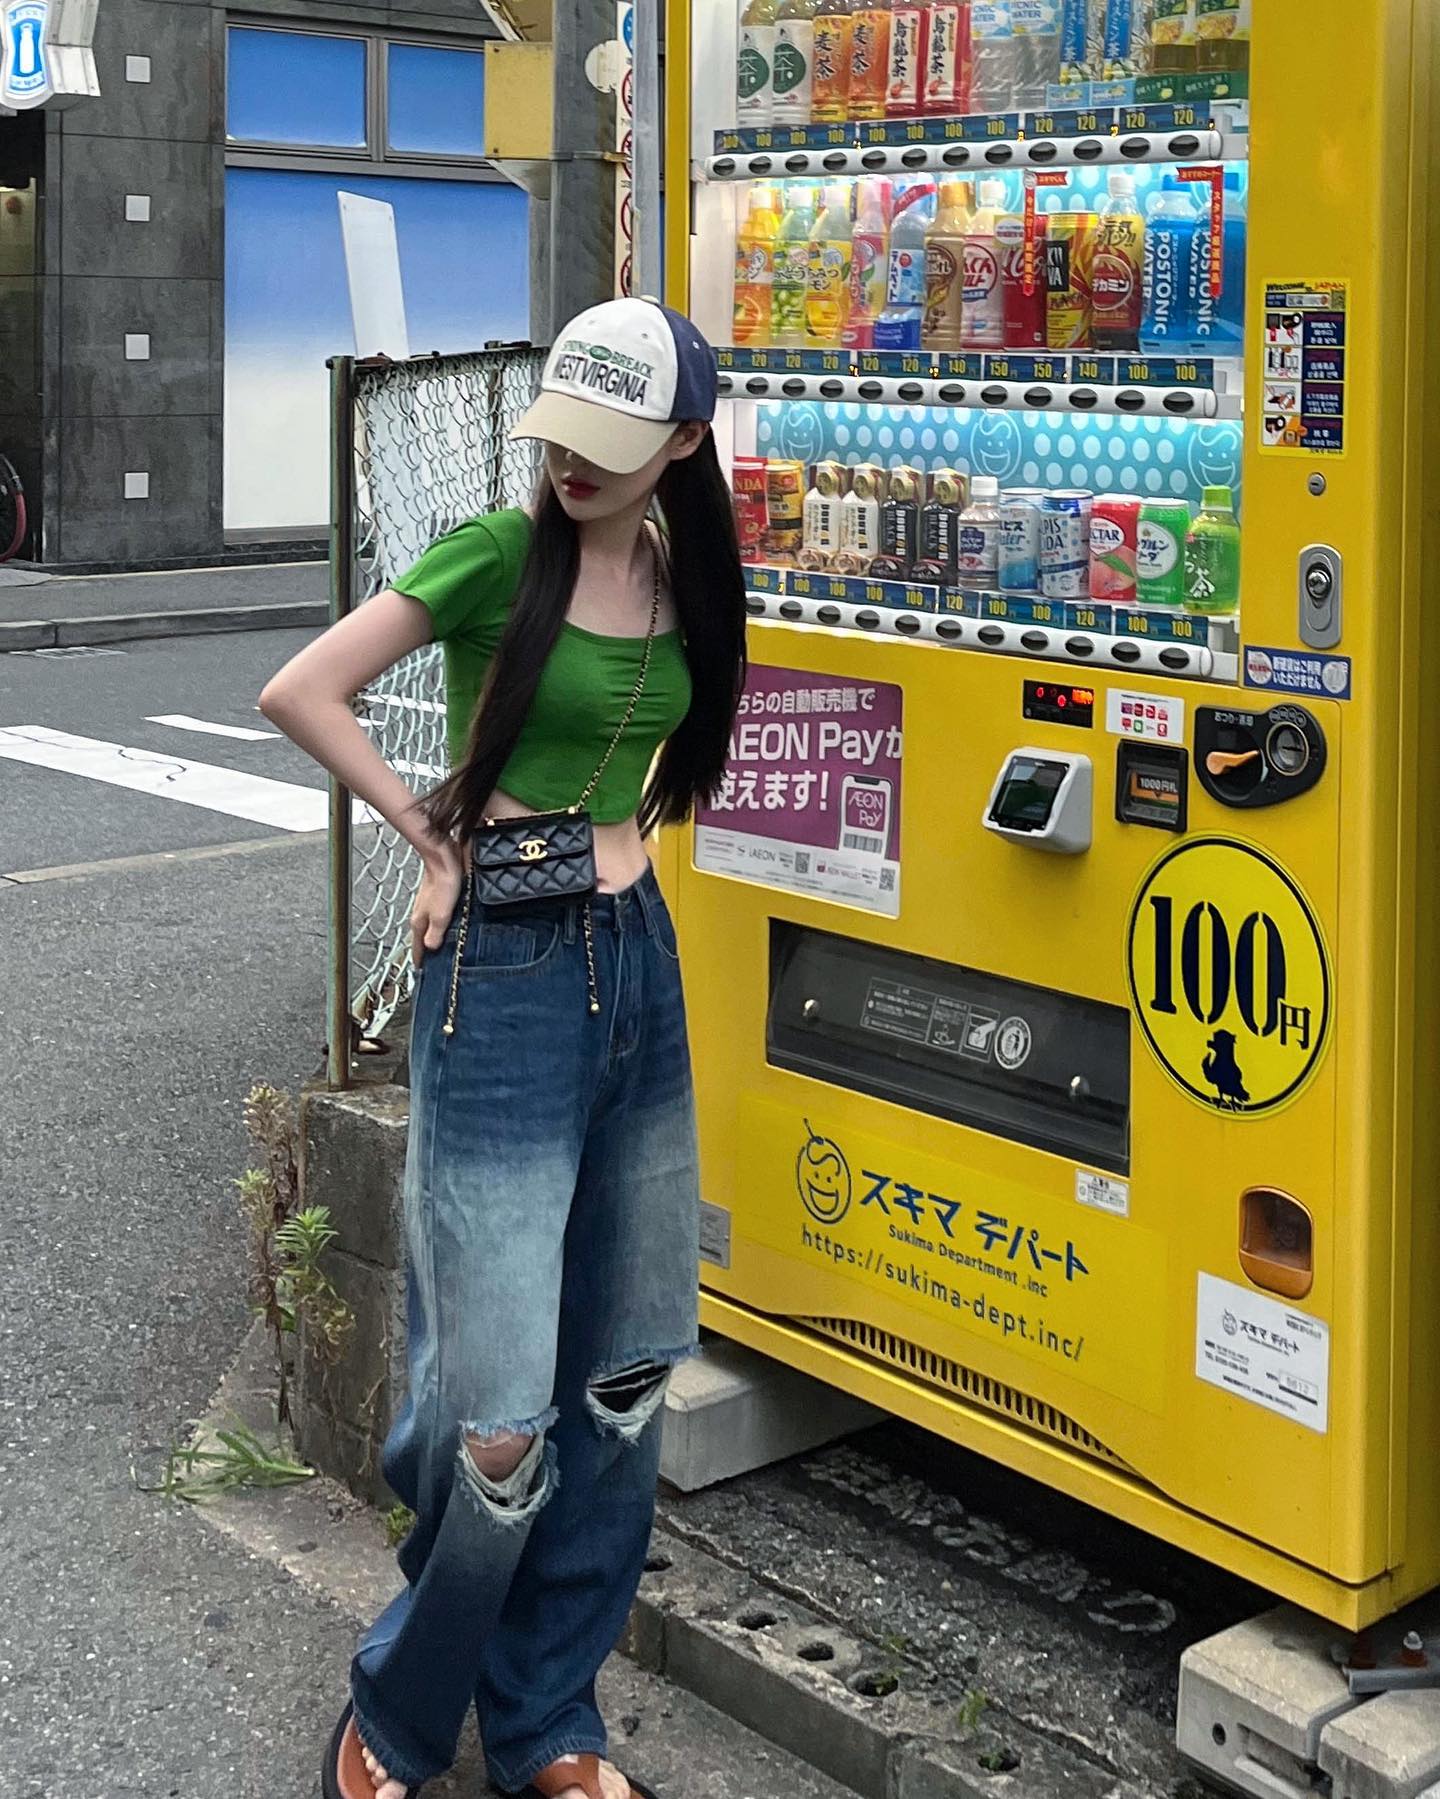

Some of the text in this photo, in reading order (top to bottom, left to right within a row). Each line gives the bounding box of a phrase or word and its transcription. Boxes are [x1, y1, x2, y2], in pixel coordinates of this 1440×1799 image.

[814, 30, 836, 81] 麦茶
[852, 24, 871, 76] 麦茶
[756, 132, 772, 147] 100
[790, 130, 806, 145] 100
[828, 128, 845, 143] 100
[868, 128, 886, 142] 100
[907, 125, 924, 140] 100
[945, 123, 963, 138] 100
[987, 120, 1005, 135] 100
[1034, 116, 1053, 133] 120
[1077, 115, 1096, 131] 120
[1126, 112, 1145, 129] 120
[1174, 109, 1193, 126] 120
[1153, 231, 1172, 335] POSTONIC
[580, 358, 648, 406] VIRGINIA
[718, 353, 1197, 381] 120 120 120 120 120 120 140 150 150 140 100 100
[866, 586, 883, 601] 100
[906, 591, 923, 606] 100
[946, 595, 963, 610] 120
[988, 600, 1007, 616] 100
[1032, 605, 1051, 621] 100
[1076, 610, 1095, 626] 120
[1128, 616, 1148, 633] 100
[1172, 620, 1192, 638] 100
[859, 1169, 1090, 1282] スキマ デパート
[888, 1224, 935, 1254] Sukima
[938, 1242, 1018, 1285] Department
[801, 1222, 1086, 1362] https://sukima-dept.inc/
